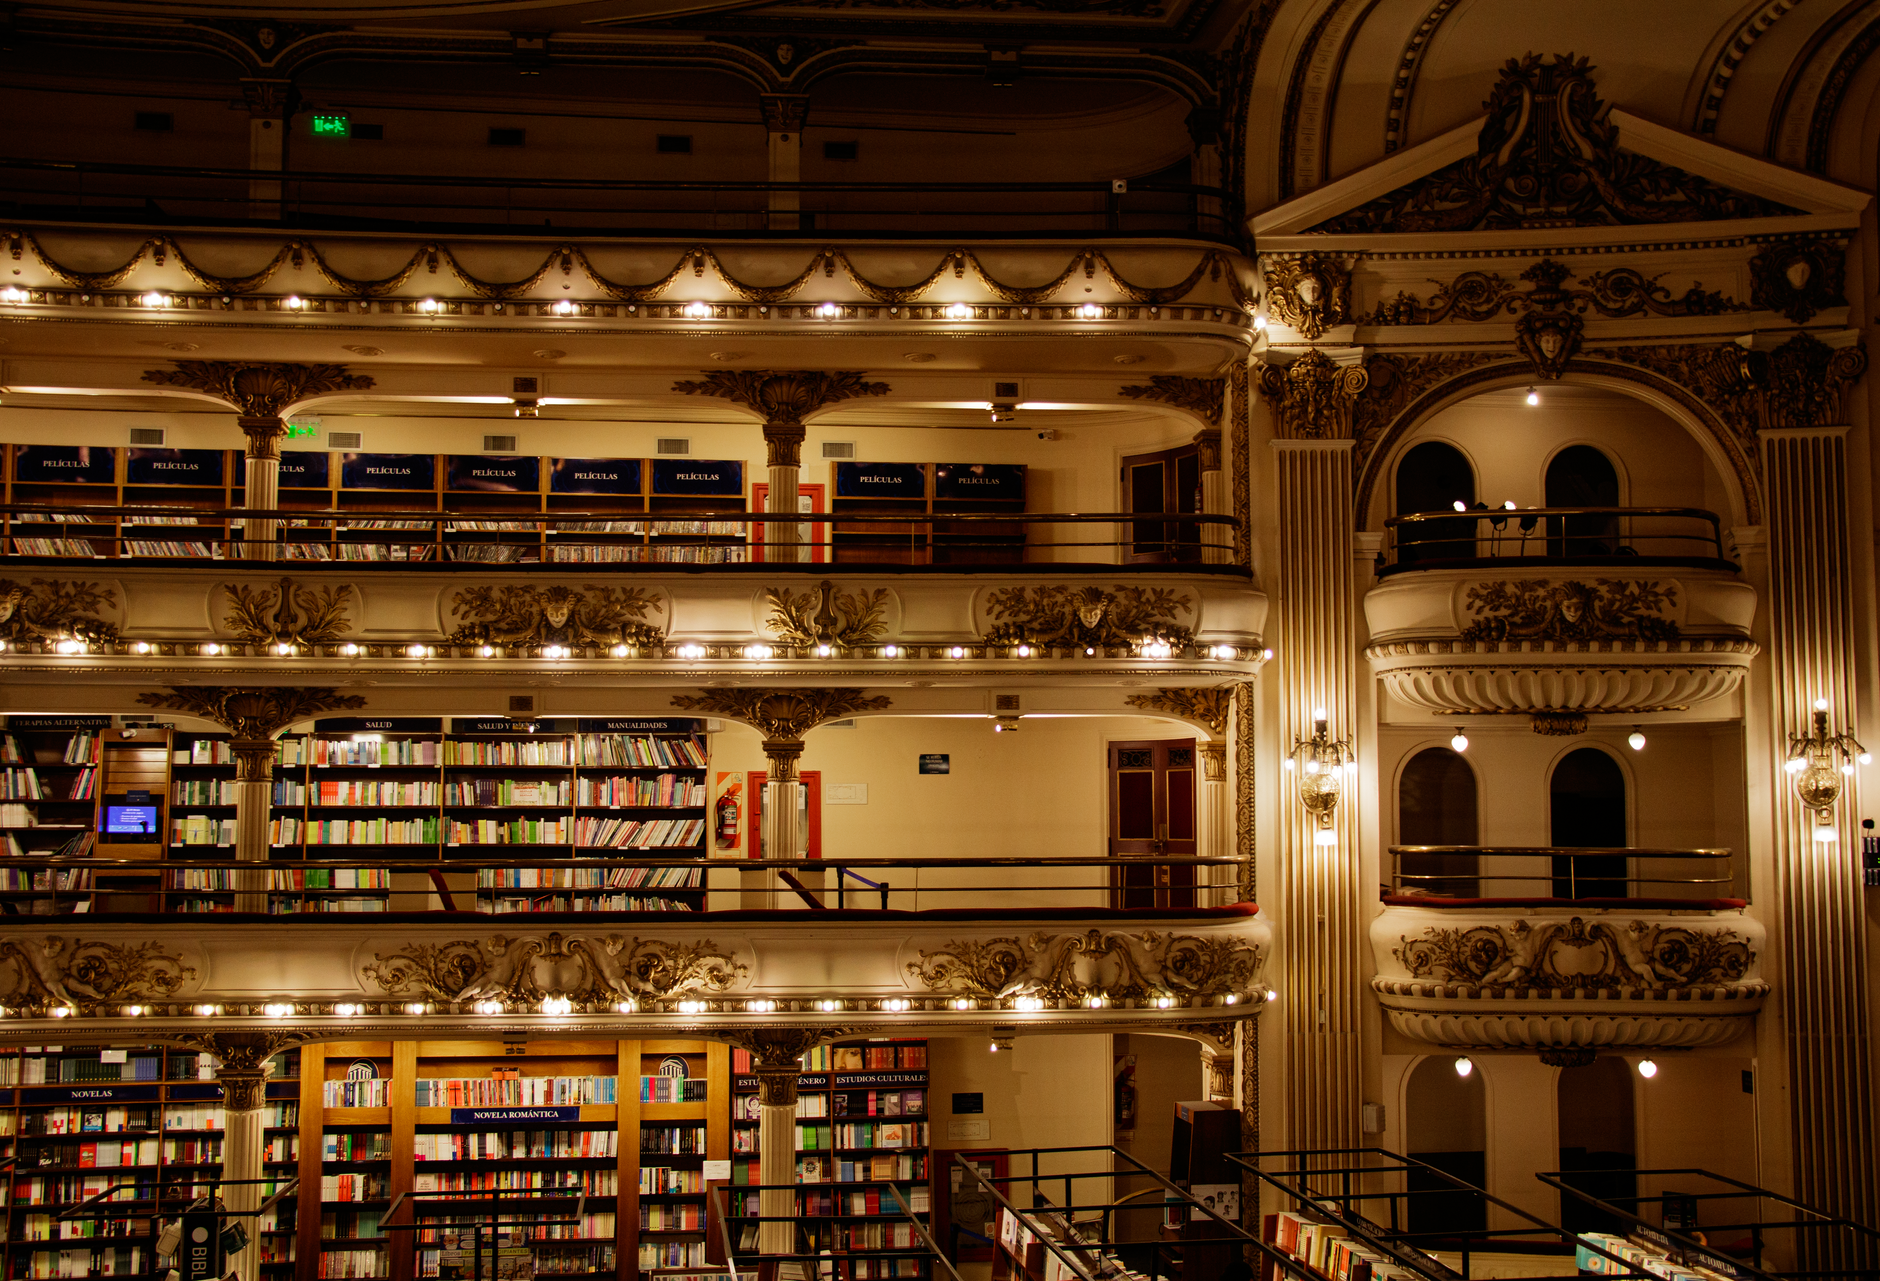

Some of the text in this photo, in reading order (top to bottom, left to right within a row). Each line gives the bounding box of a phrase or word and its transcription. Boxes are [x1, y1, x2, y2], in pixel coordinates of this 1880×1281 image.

[43, 459, 90, 468] PELÍCULAS
[153, 461, 199, 470] PELÍCULAS
[278, 465, 305, 473] CULAS
[366, 466, 411, 475] PELÍCULAS
[472, 468, 516, 477] PELÍCULAS
[574, 472, 618, 480] PELÍCULAS
[676, 473, 720, 481] PELÍCULAS
[860, 475, 902, 484] PELÍCULAS
[958, 477, 1000, 485] PELÍCULAS
[477, 722, 503, 730] SALUD
[503, 722, 511, 730] Y
[797, 1076, 826, 1085] ÉNERO
[836, 1076, 876, 1084] ESTUDIOS
[71, 1089, 113, 1098] NOVELAS
[474, 1109, 559, 1119] NOVELA ROMÁNTICA
[1698, 1253, 1738, 1276] AUTOAYUDA
